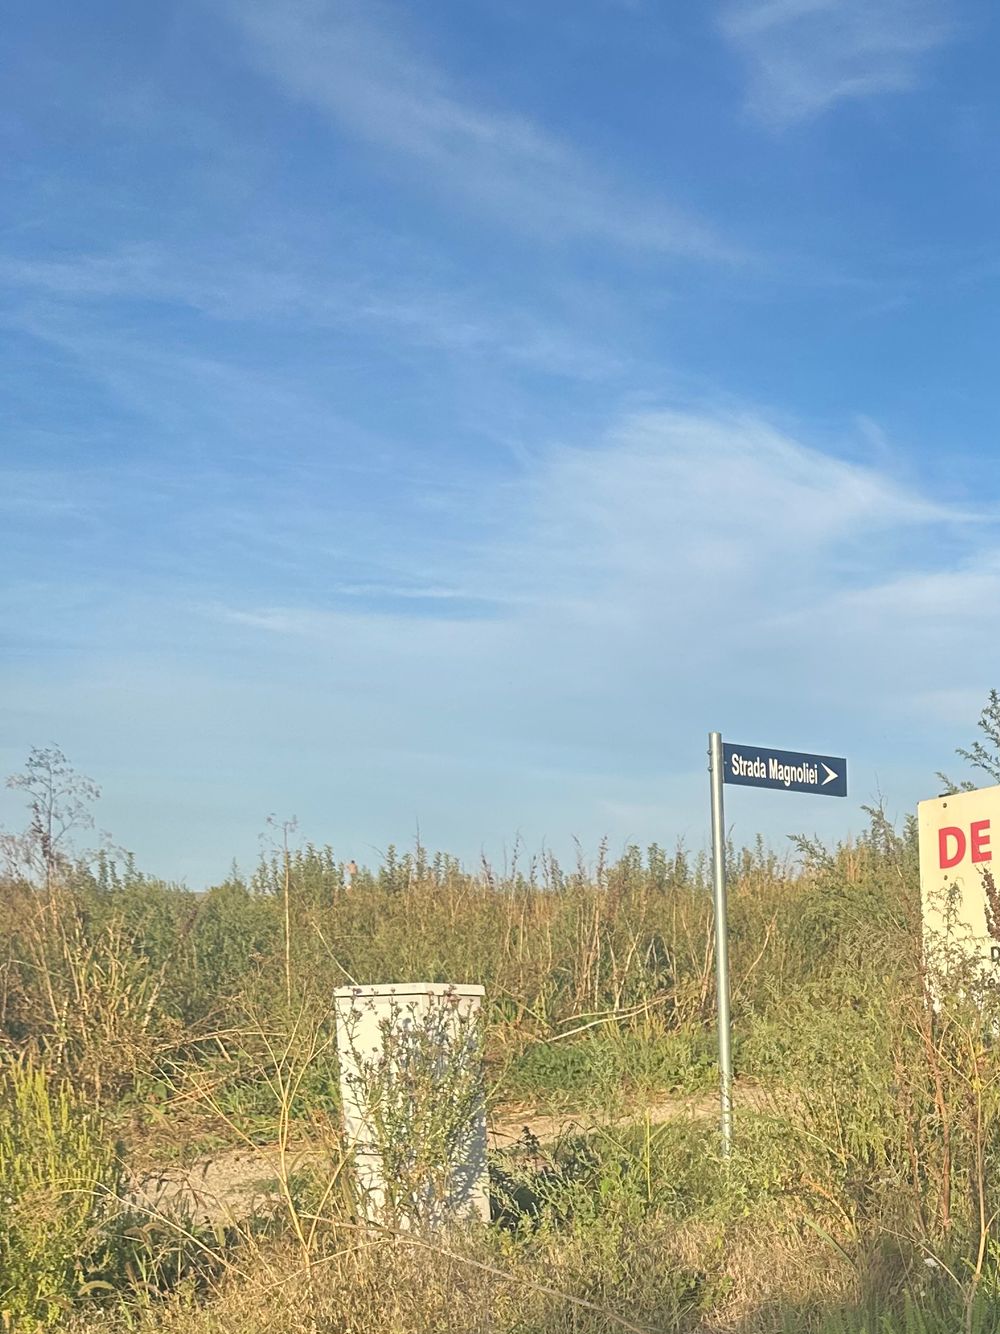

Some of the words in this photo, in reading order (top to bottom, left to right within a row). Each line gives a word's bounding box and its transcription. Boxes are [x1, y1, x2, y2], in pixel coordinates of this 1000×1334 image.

[731, 753, 766, 779] Strada
[768, 758, 818, 787] Magnoliei
[938, 818, 993, 869] DE
